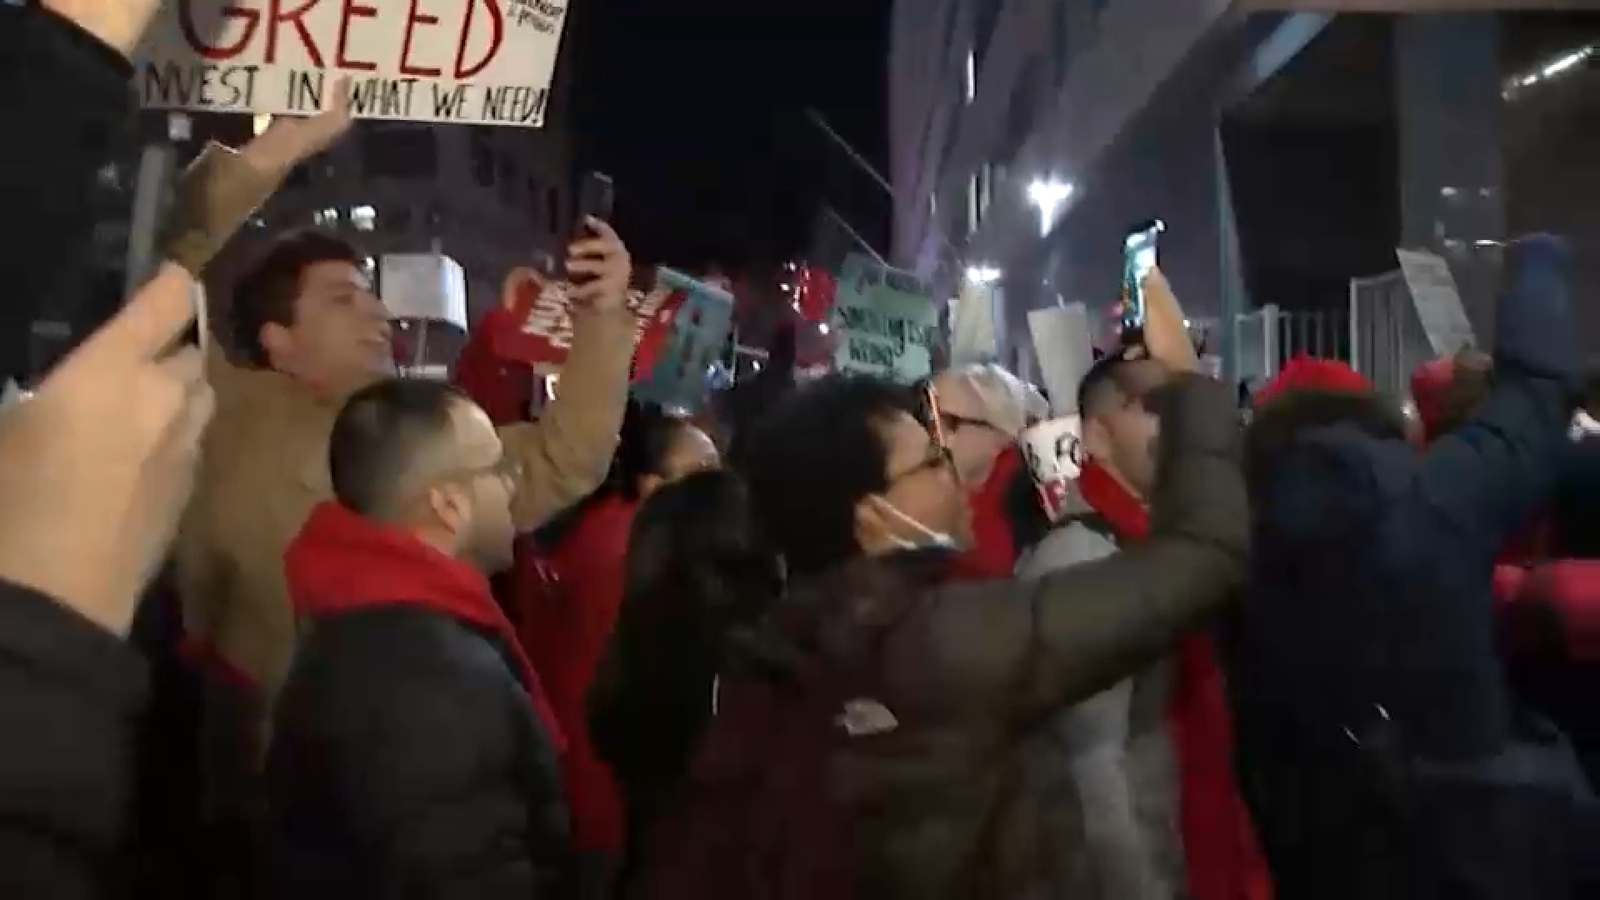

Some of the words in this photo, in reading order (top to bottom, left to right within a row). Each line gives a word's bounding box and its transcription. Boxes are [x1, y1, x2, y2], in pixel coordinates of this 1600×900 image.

[178, 0, 503, 79] GREED
[144, 61, 259, 107] NVEST
[287, 68, 324, 110] IN
[346, 77, 419, 116] WHAT
[431, 83, 473, 118] WE
[481, 86, 545, 123] NEED!
